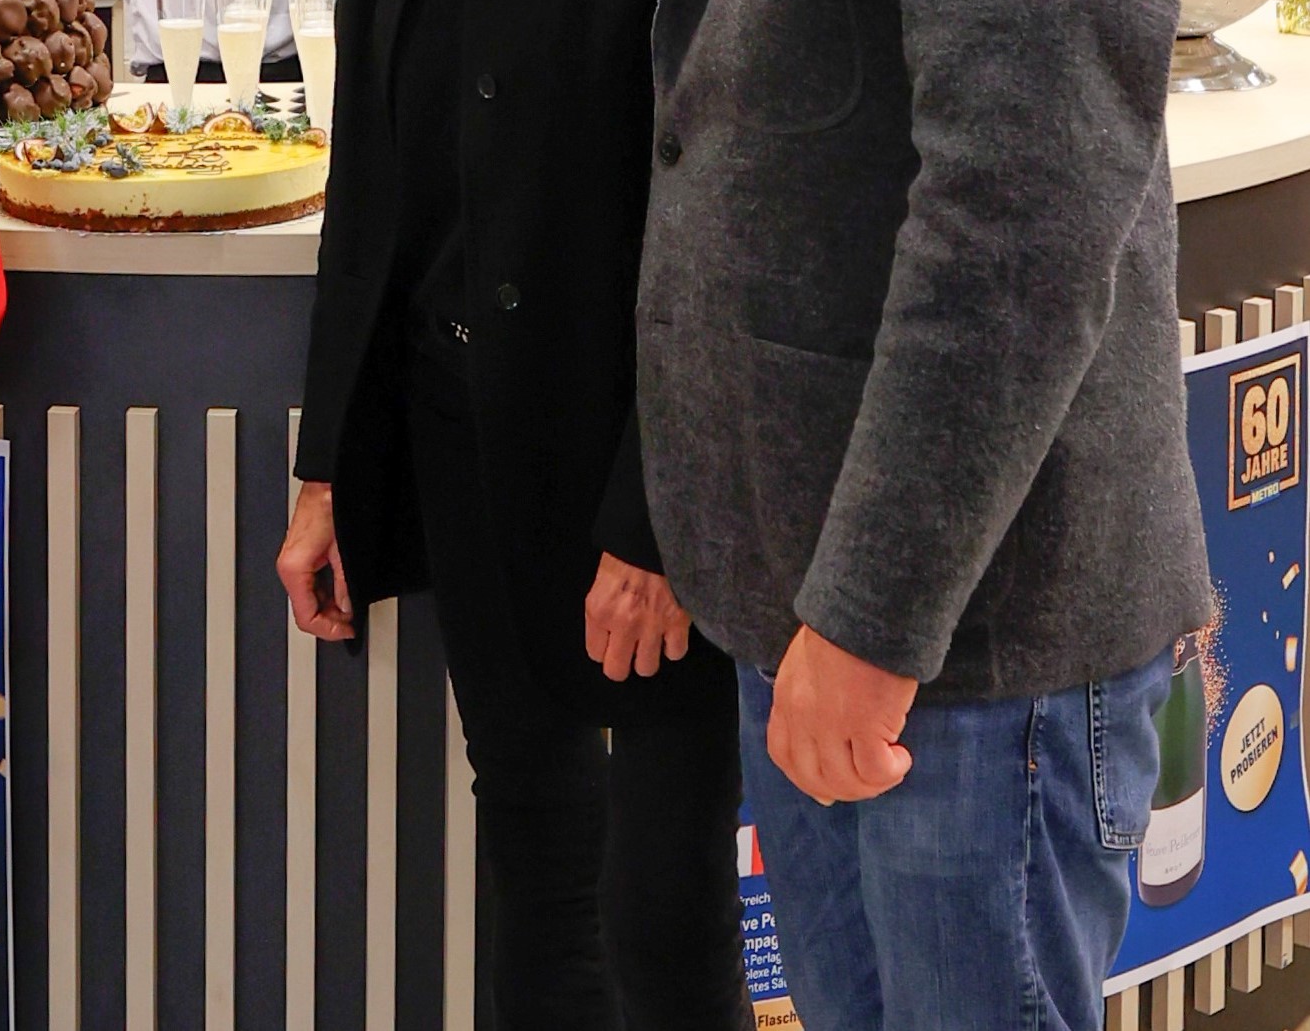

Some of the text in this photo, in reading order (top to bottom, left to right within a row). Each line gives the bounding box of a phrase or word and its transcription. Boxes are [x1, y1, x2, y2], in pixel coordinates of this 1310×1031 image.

[1241, 377, 1290, 455] 60
[1241, 443, 1289, 484] JAHRE
[1251, 481, 1280, 504] METRO
[1240, 717, 1265, 754] JETZT
[1230, 725, 1279, 784] PROBIEREN
[741, 918, 759, 932] ve
[750, 952, 783, 966] Perlag
[748, 981, 770, 993] ntes
[757, 1011, 797, 1028] Flasch
